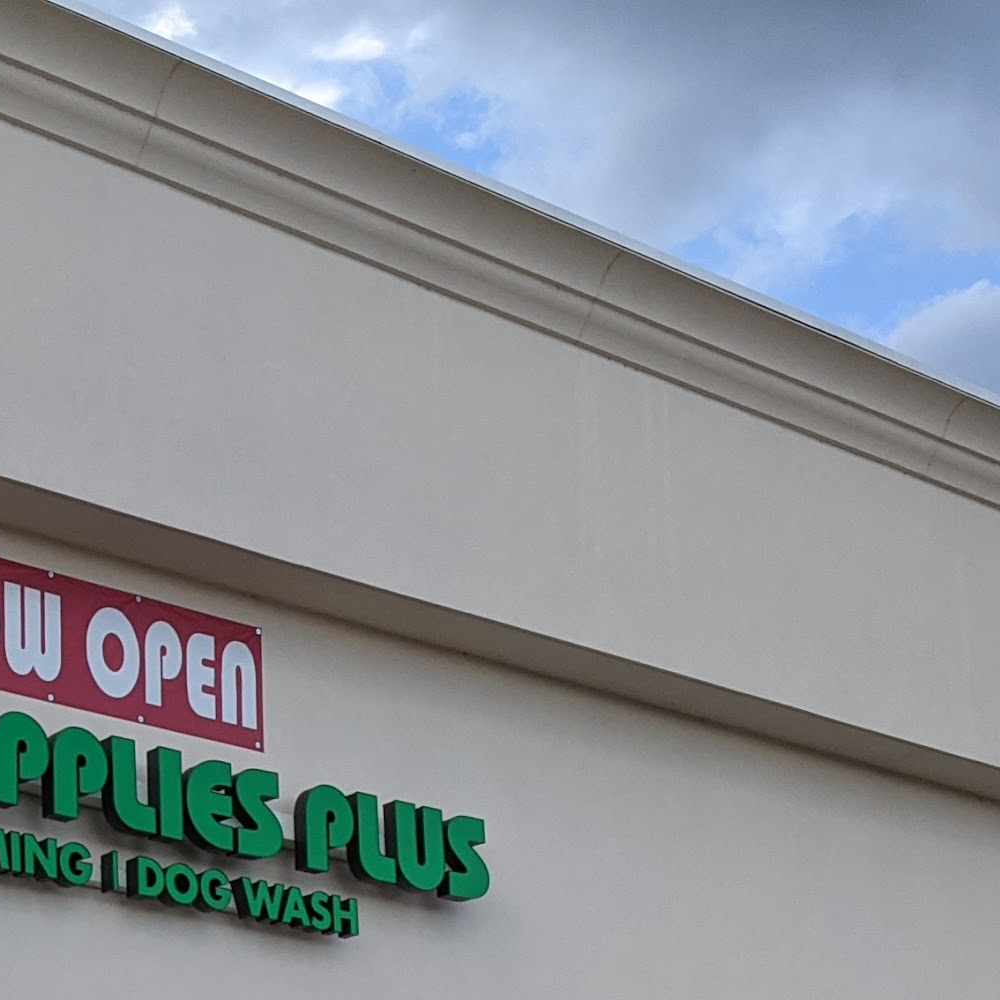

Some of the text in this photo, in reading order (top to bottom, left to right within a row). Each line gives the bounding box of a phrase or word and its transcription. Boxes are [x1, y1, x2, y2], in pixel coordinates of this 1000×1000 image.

[86, 606, 258, 730] OPEN
[127, 856, 233, 911] DOG
[233, 877, 360, 938] WASH
[295, 785, 490, 901] PLUS
